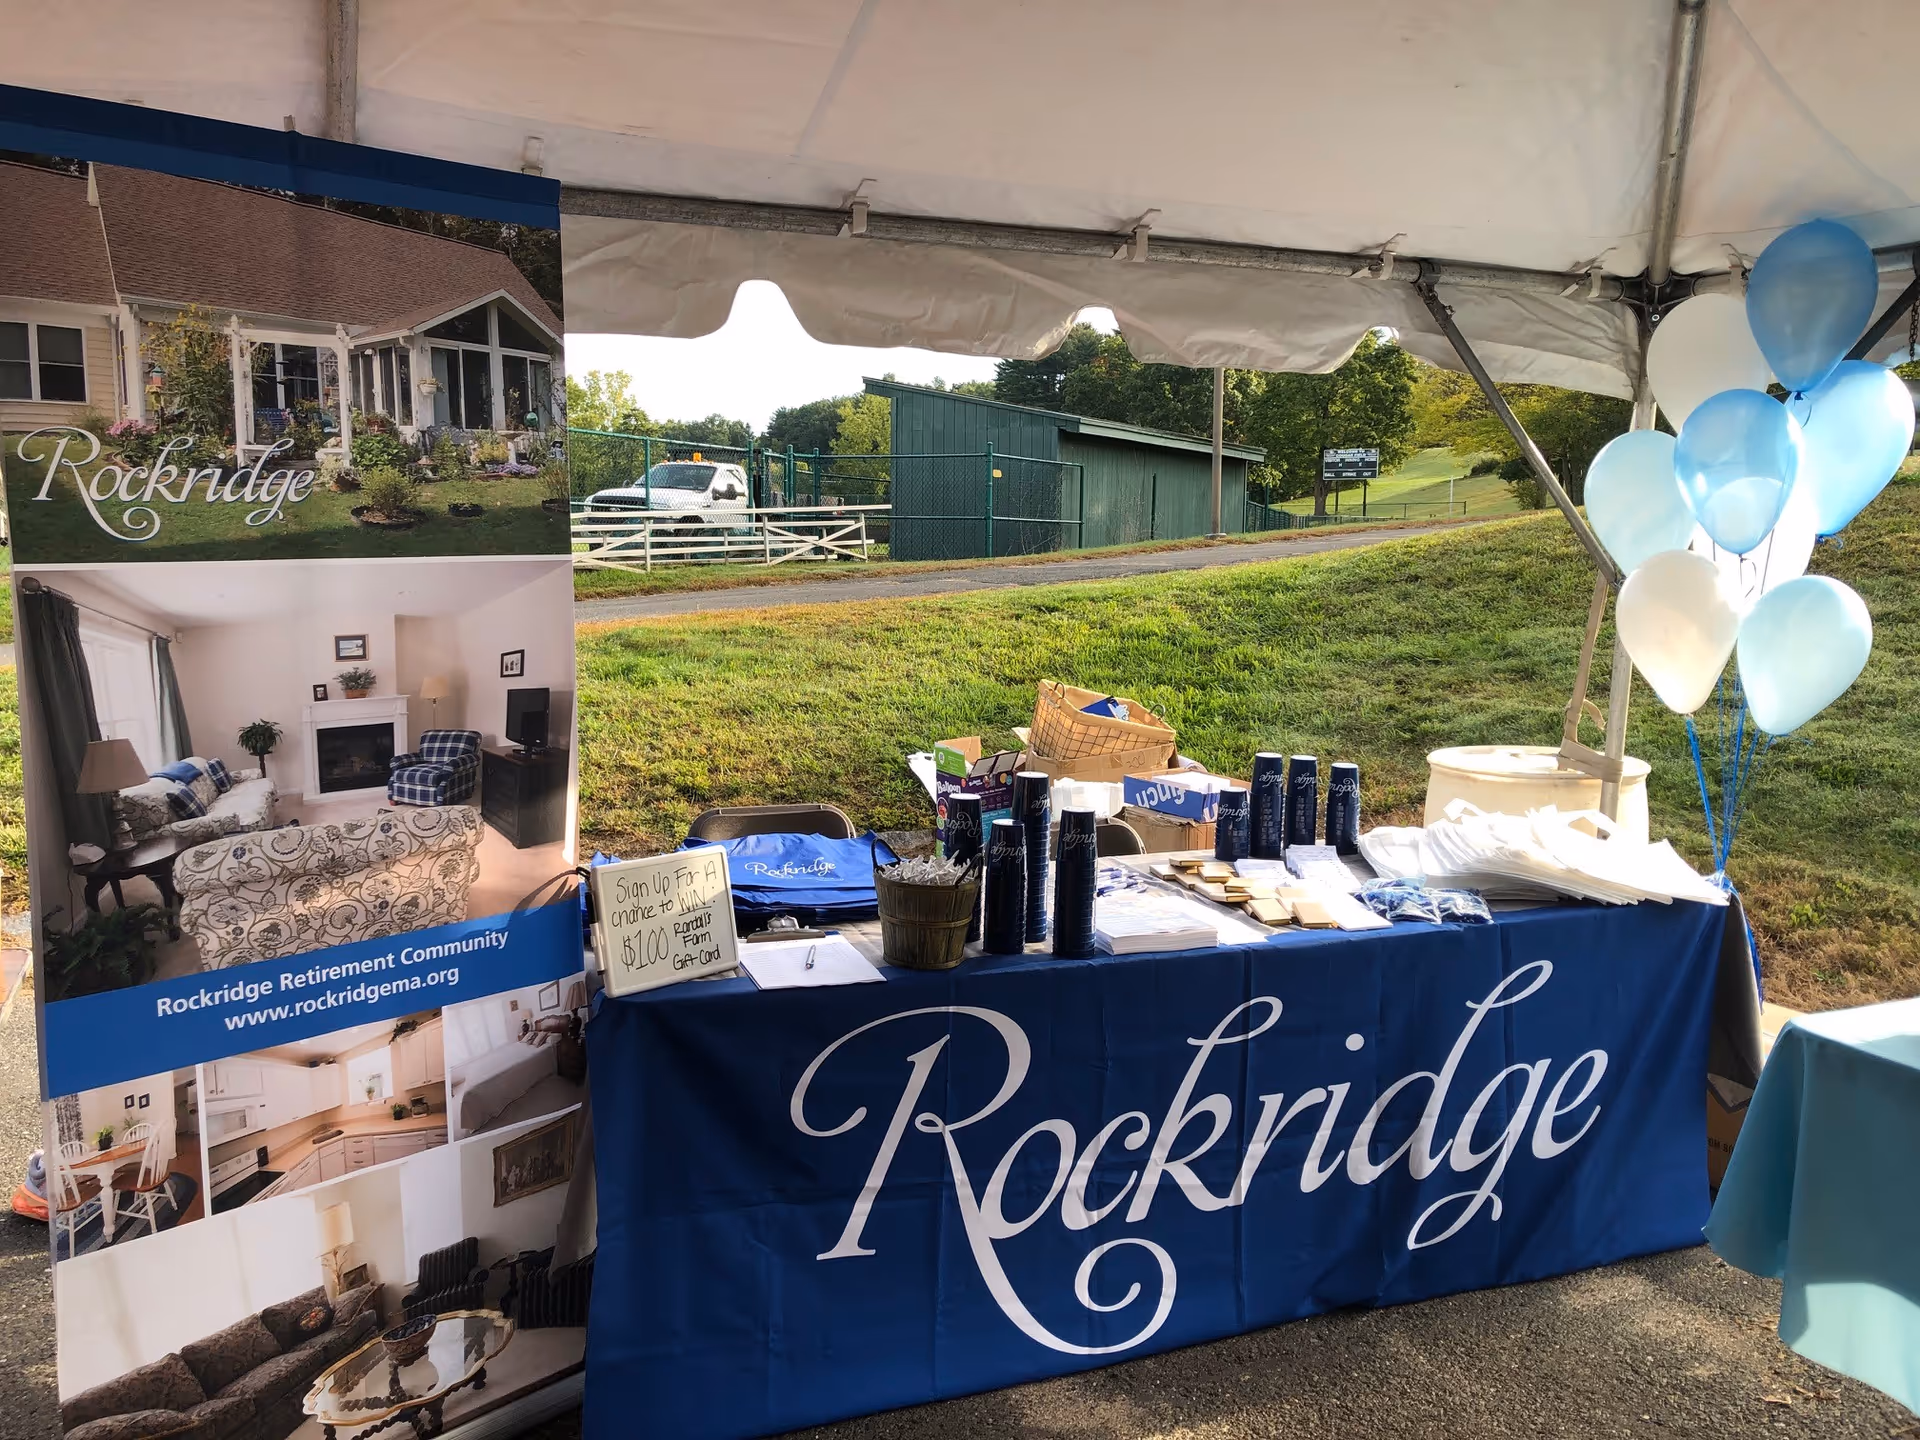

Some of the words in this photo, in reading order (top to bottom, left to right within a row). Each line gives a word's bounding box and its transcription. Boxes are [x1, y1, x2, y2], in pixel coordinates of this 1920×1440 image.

[17, 426, 317, 542] Rockridge
[936, 780, 962, 794] Balloon
[616, 877, 649, 908] Sign
[652, 871, 670, 896] Up
[673, 866, 700, 889] For
[704, 860, 717, 882] A
[744, 856, 837, 879] Rockridge
[612, 904, 657, 928] chance
[659, 899, 673, 913] to
[673, 911, 712, 937] Randall's
[621, 926, 669, 972] $100
[673, 953, 698, 971] Gift
[699, 943, 721, 965] Card
[682, 931, 712, 948] Farm
[156, 980, 273, 1017] Rockridge
[279, 952, 396, 991] Retirement
[400, 929, 510, 966] Community
[224, 966, 460, 1031] www.rockridgema.org
[789, 959, 1608, 1354] Rockridge
